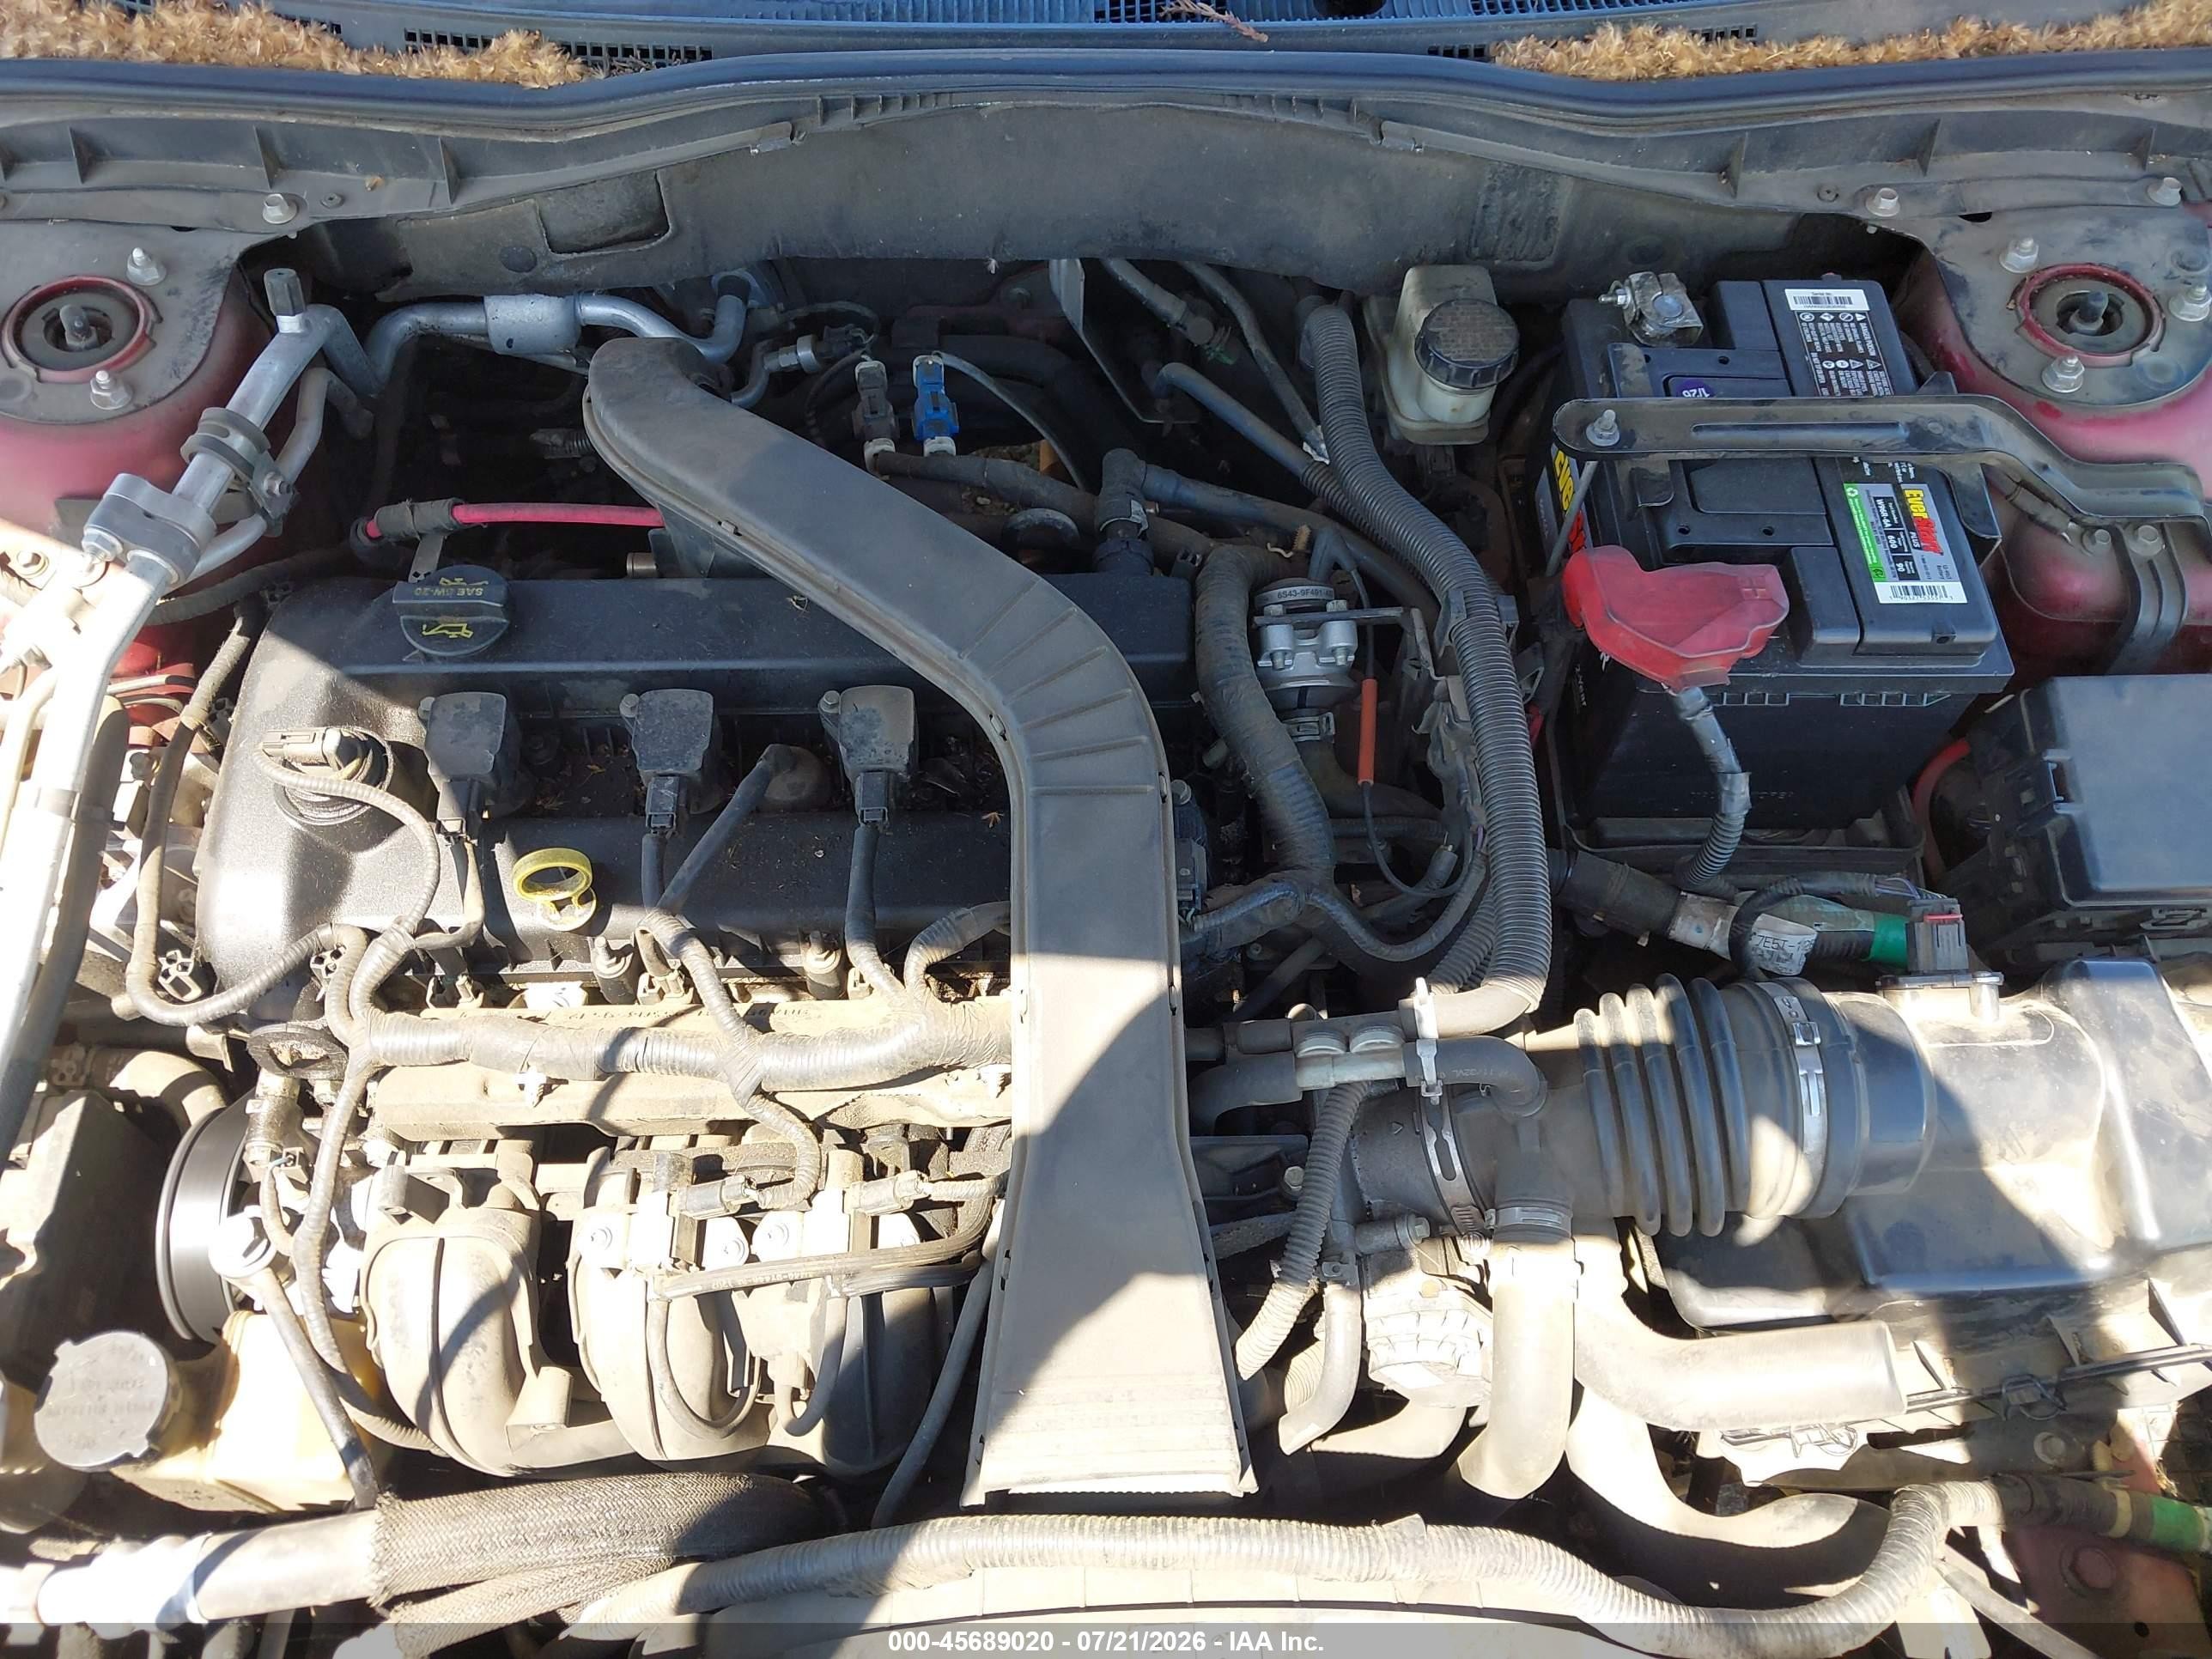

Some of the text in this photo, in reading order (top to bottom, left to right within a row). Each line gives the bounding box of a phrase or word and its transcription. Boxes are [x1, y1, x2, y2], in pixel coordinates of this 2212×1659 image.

[1887, 535, 1898, 548] 600
[1909, 532, 1921, 548] PLUS
[1895, 562, 1905, 571] 90
[457, 587, 483, 596] SAE
